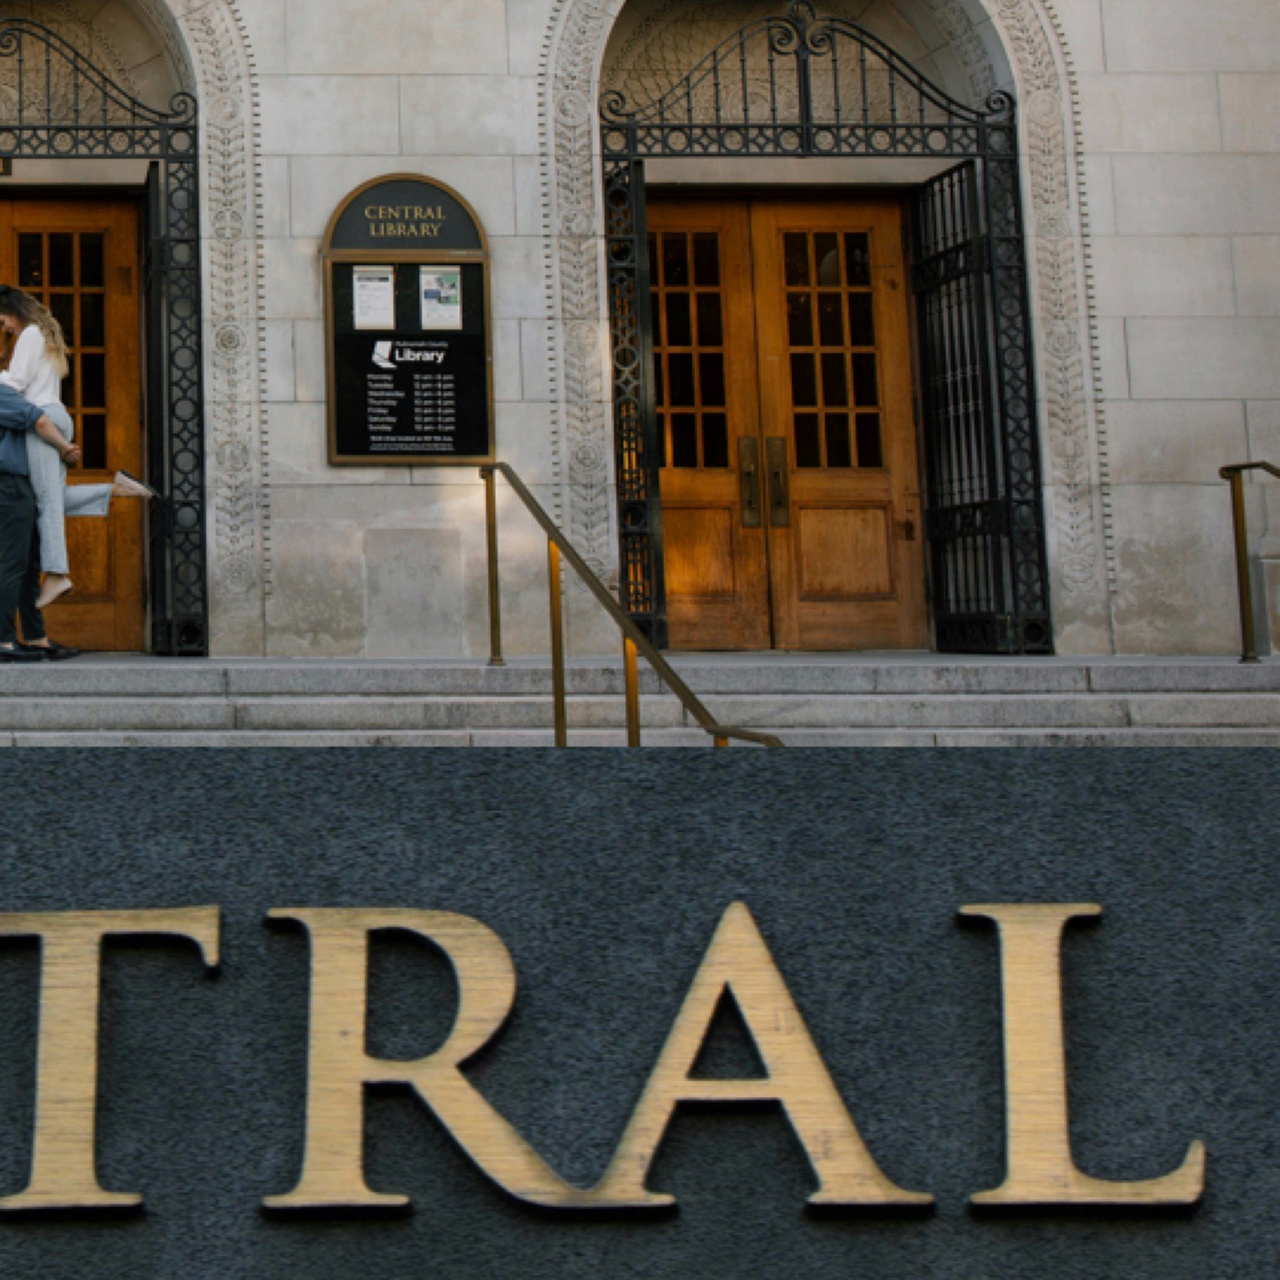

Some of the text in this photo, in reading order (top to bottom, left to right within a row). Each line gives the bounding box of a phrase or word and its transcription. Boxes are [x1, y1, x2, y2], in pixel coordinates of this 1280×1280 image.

[364, 205, 446, 220] CENTRAL
[370, 222, 442, 237] LIBRARY
[394, 348, 446, 364] Library
